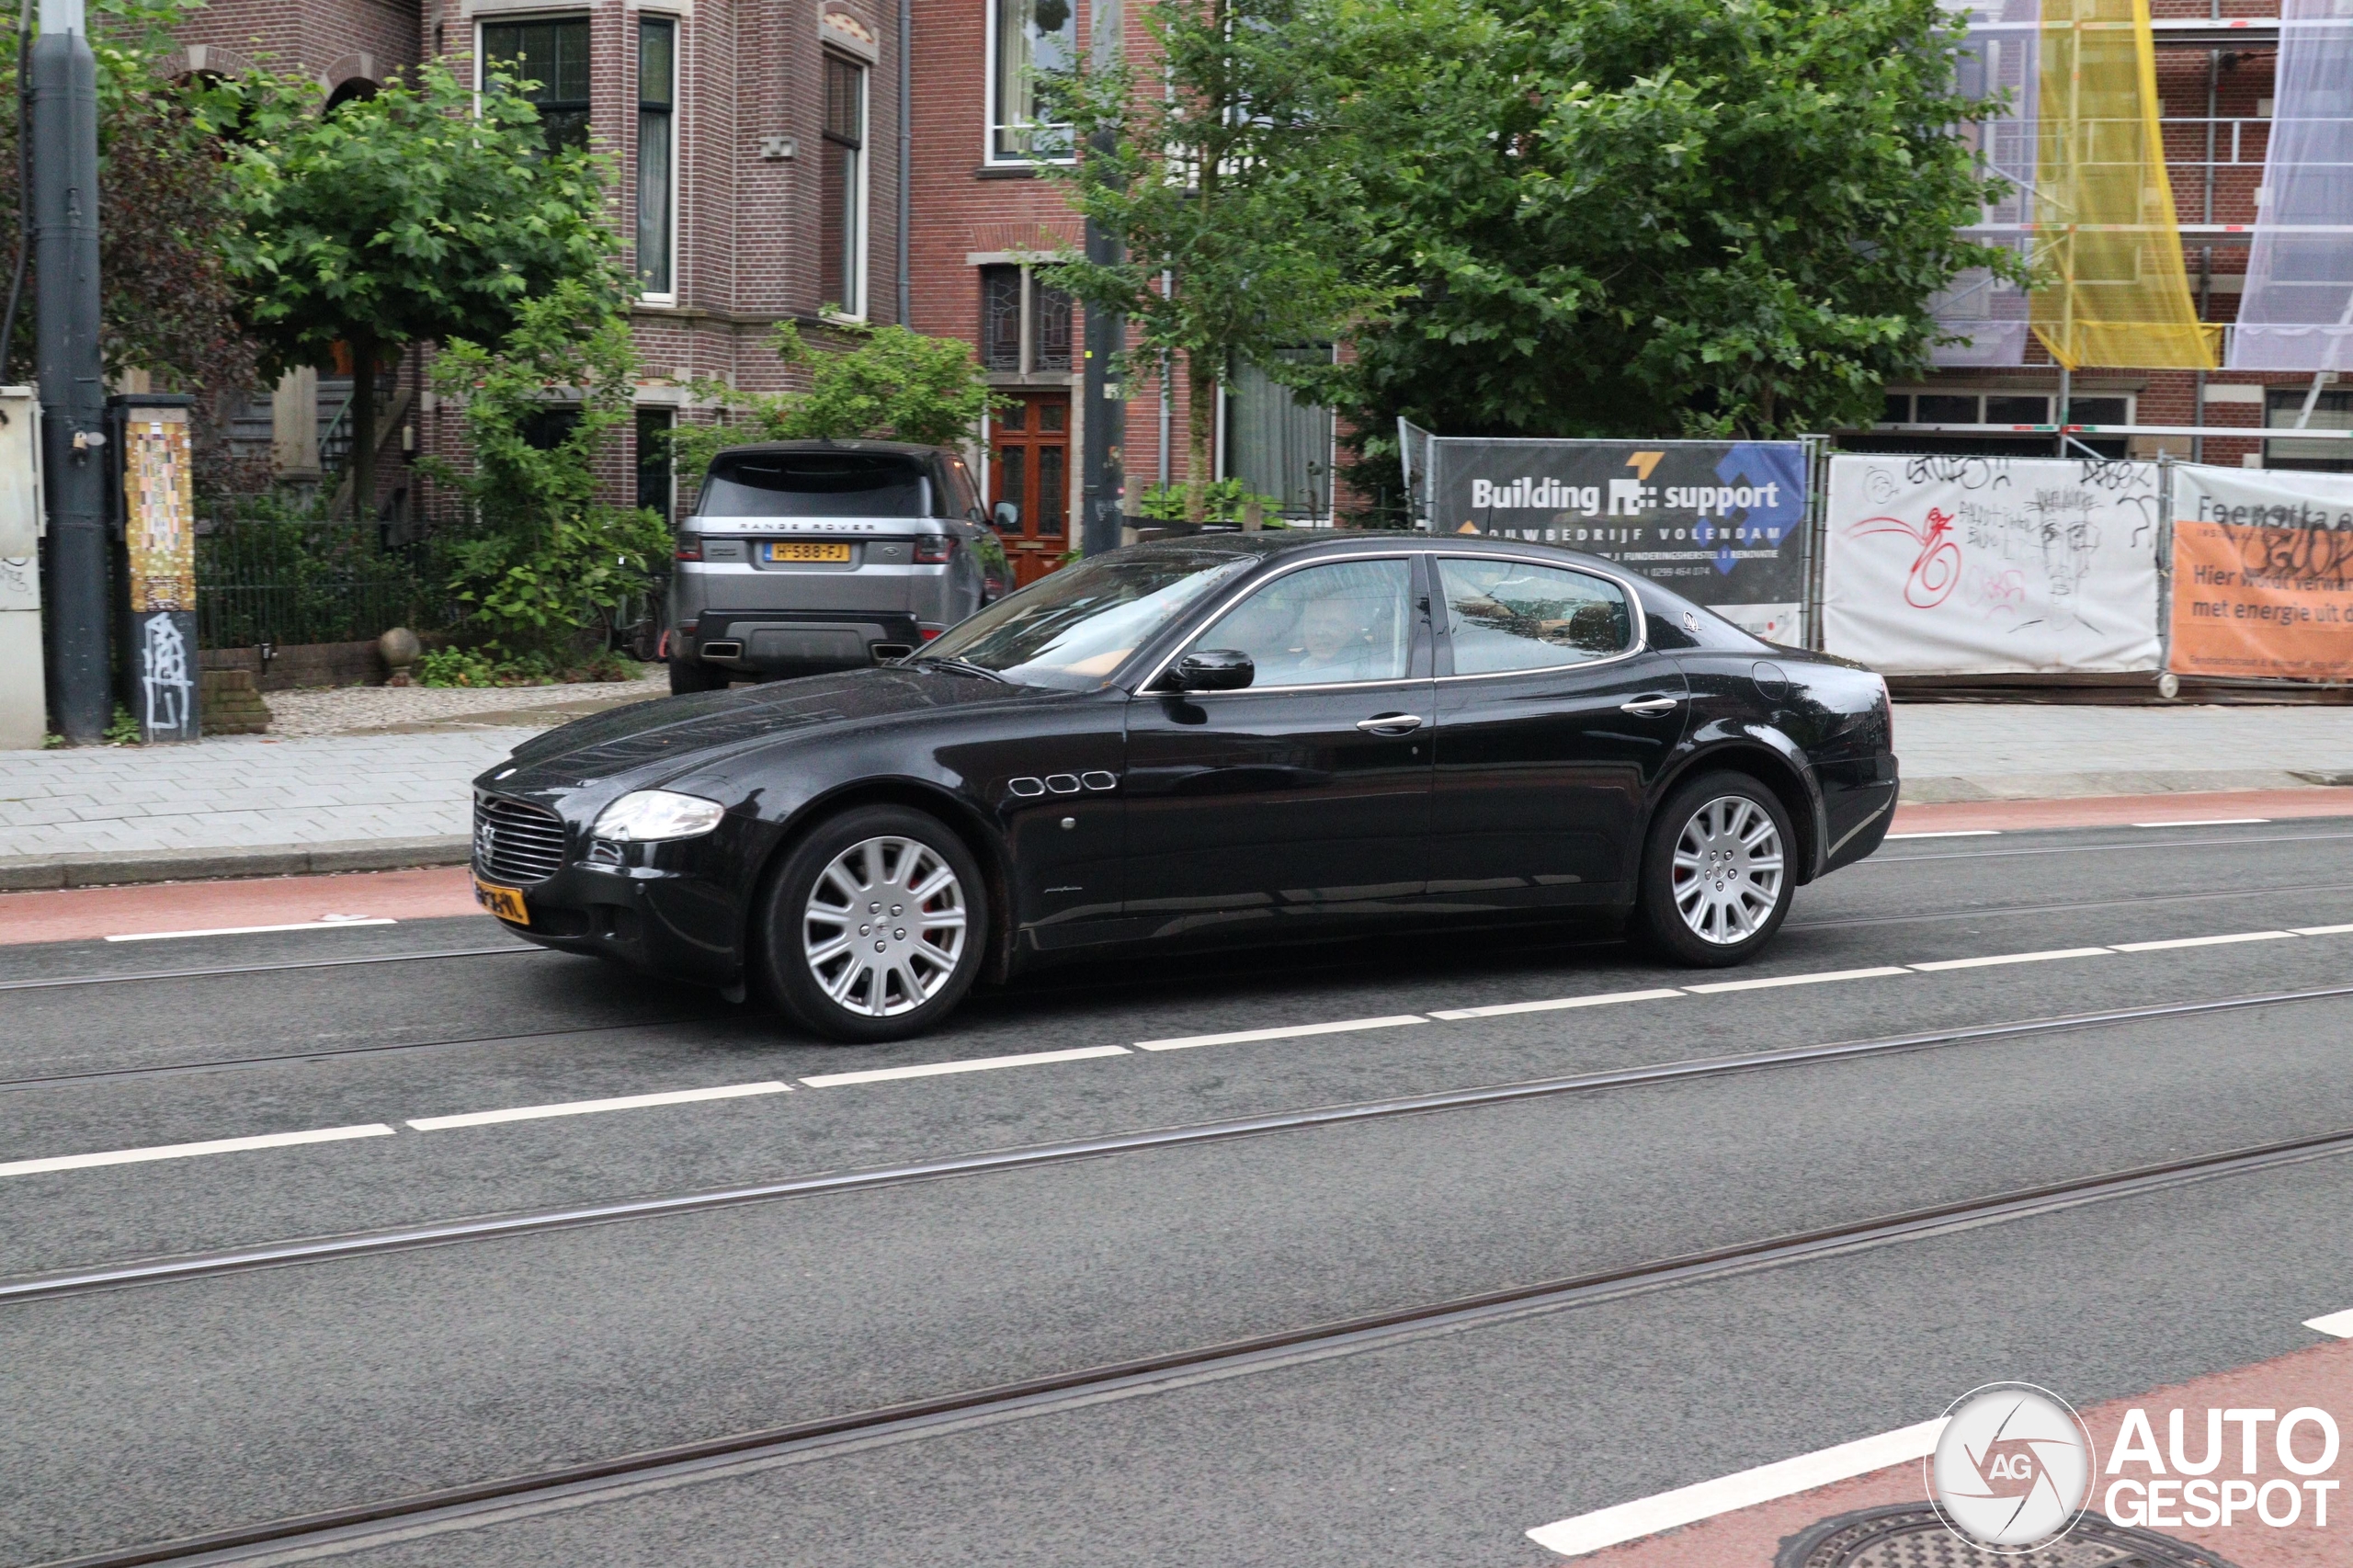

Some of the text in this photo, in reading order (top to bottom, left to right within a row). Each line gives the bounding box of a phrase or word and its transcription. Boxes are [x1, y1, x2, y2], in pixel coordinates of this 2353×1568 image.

[1471, 476, 1780, 517] Building support
[813, 523, 876, 531] ROVER
[1658, 527, 1781, 540] VOLENDAM
[776, 543, 844, 559] H-588-FJ
[2193, 563, 2235, 586] Hier
[2193, 599, 2229, 618] met
[2234, 602, 2310, 626] energie
[2314, 603, 2340, 623] uit
